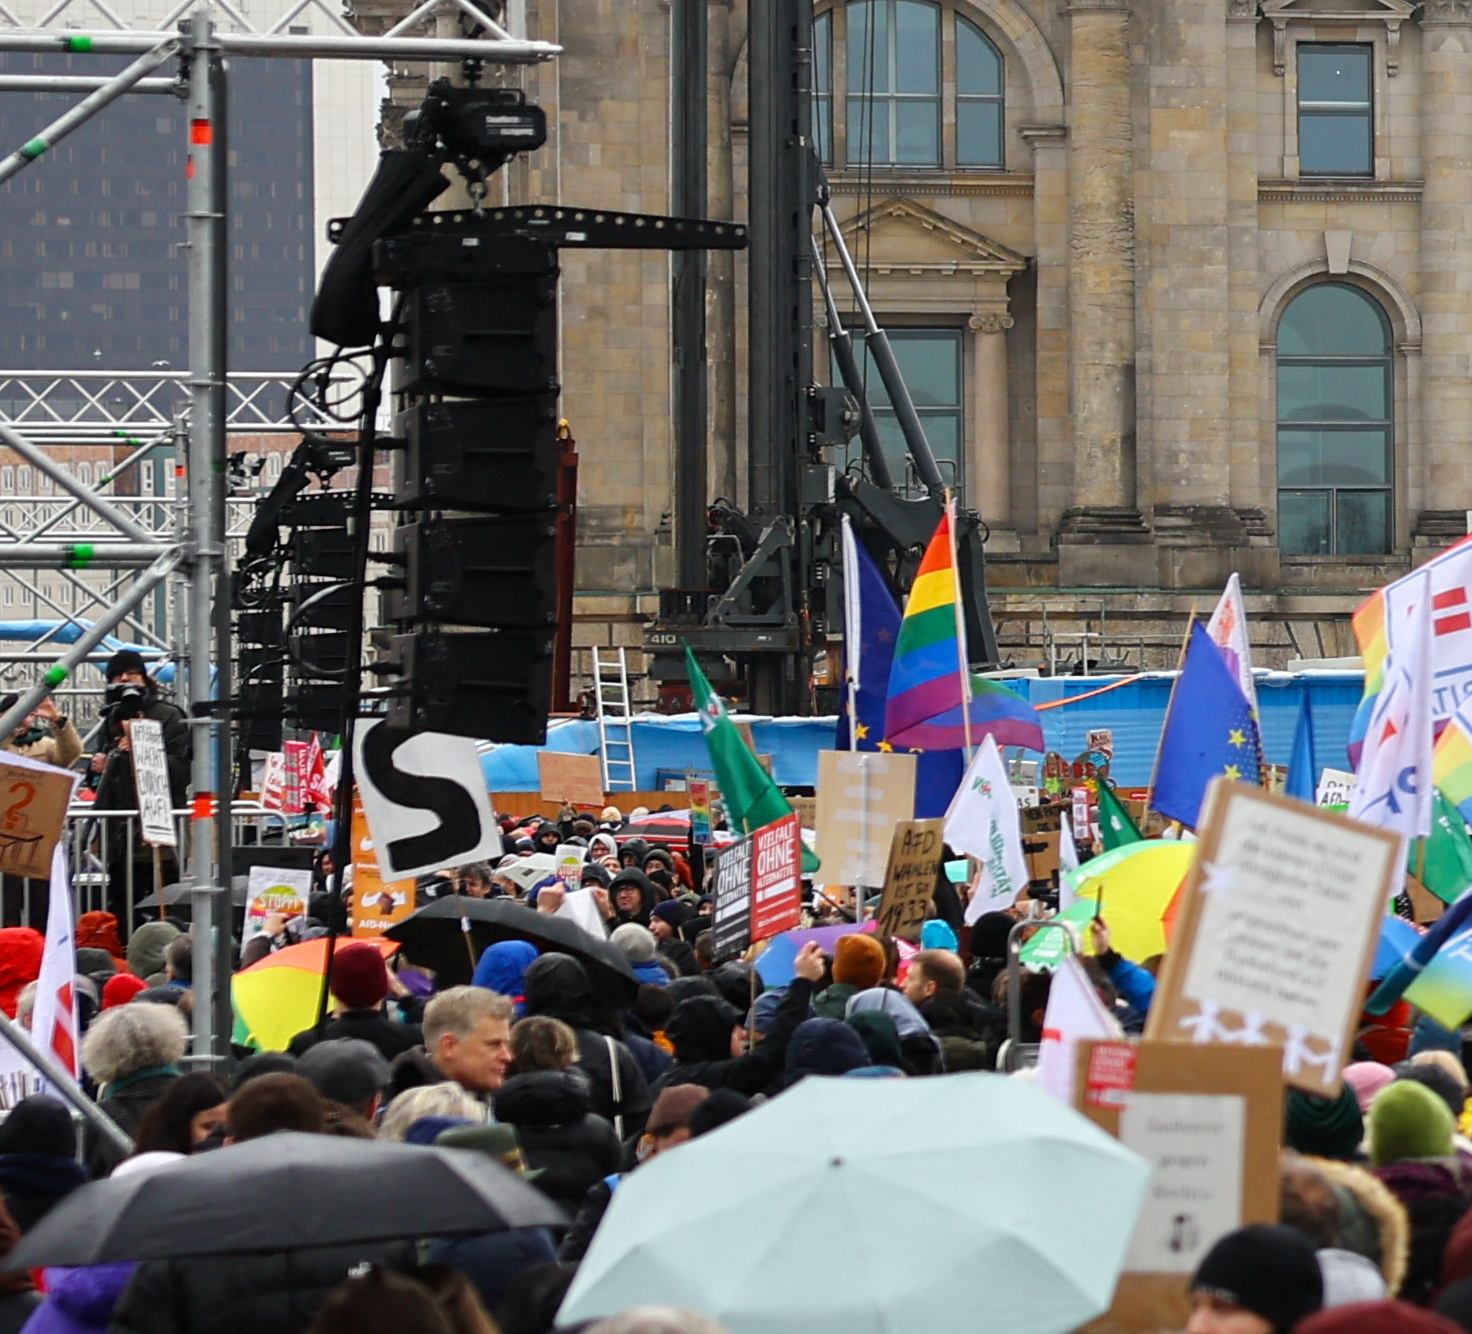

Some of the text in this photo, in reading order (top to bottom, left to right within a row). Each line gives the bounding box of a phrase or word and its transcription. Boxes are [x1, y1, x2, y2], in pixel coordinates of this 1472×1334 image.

[756, 820, 797, 850] VIELFALT
[718, 839, 750, 866] VIELFALT
[756, 842, 796, 876] OHNE
[717, 858, 750, 896] OHNE
[756, 864, 798, 889] ALTERNATIVE
